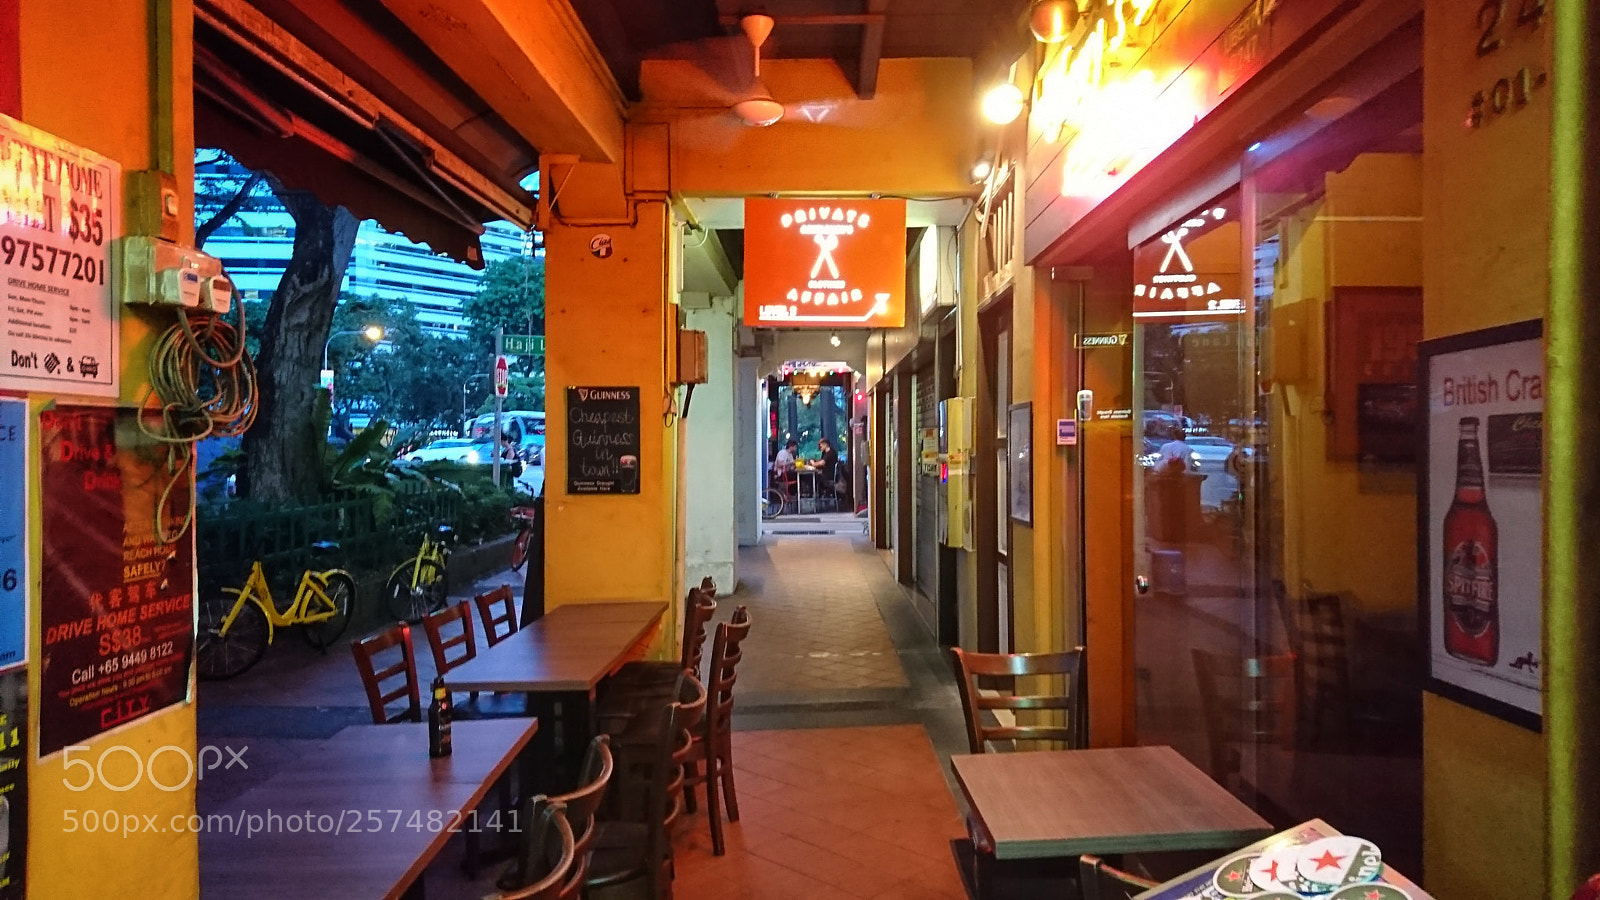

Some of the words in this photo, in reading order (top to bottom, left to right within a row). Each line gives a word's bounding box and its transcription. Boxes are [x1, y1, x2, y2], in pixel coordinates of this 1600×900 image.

[69, 198, 103, 247] $35
[781, 207, 870, 228] PRIVATE
[1, 235, 104, 286] 97577201
[27, 281, 46, 293] HOME
[47, 285, 70, 297] SERVICE
[786, 288, 863, 306] AFFAIR
[505, 337, 534, 352] Haji
[11, 350, 38, 369] Don't
[67, 357, 75, 372] &
[590, 389, 631, 400] GUINNESS
[1443, 372, 1498, 406] British
[570, 407, 635, 432] Cheapest
[61, 441, 100, 461] Drive
[46, 618, 93, 645] DRIVE
[96, 607, 137, 632] HOME
[139, 594, 190, 621] SERVICE
[99, 625, 142, 656] S$38
[71, 664, 95, 685] Call
[98, 657, 119, 676] +65
[121, 650, 147, 670] 9449
[149, 641, 173, 661] 8122
[100, 695, 151, 728] CITY
